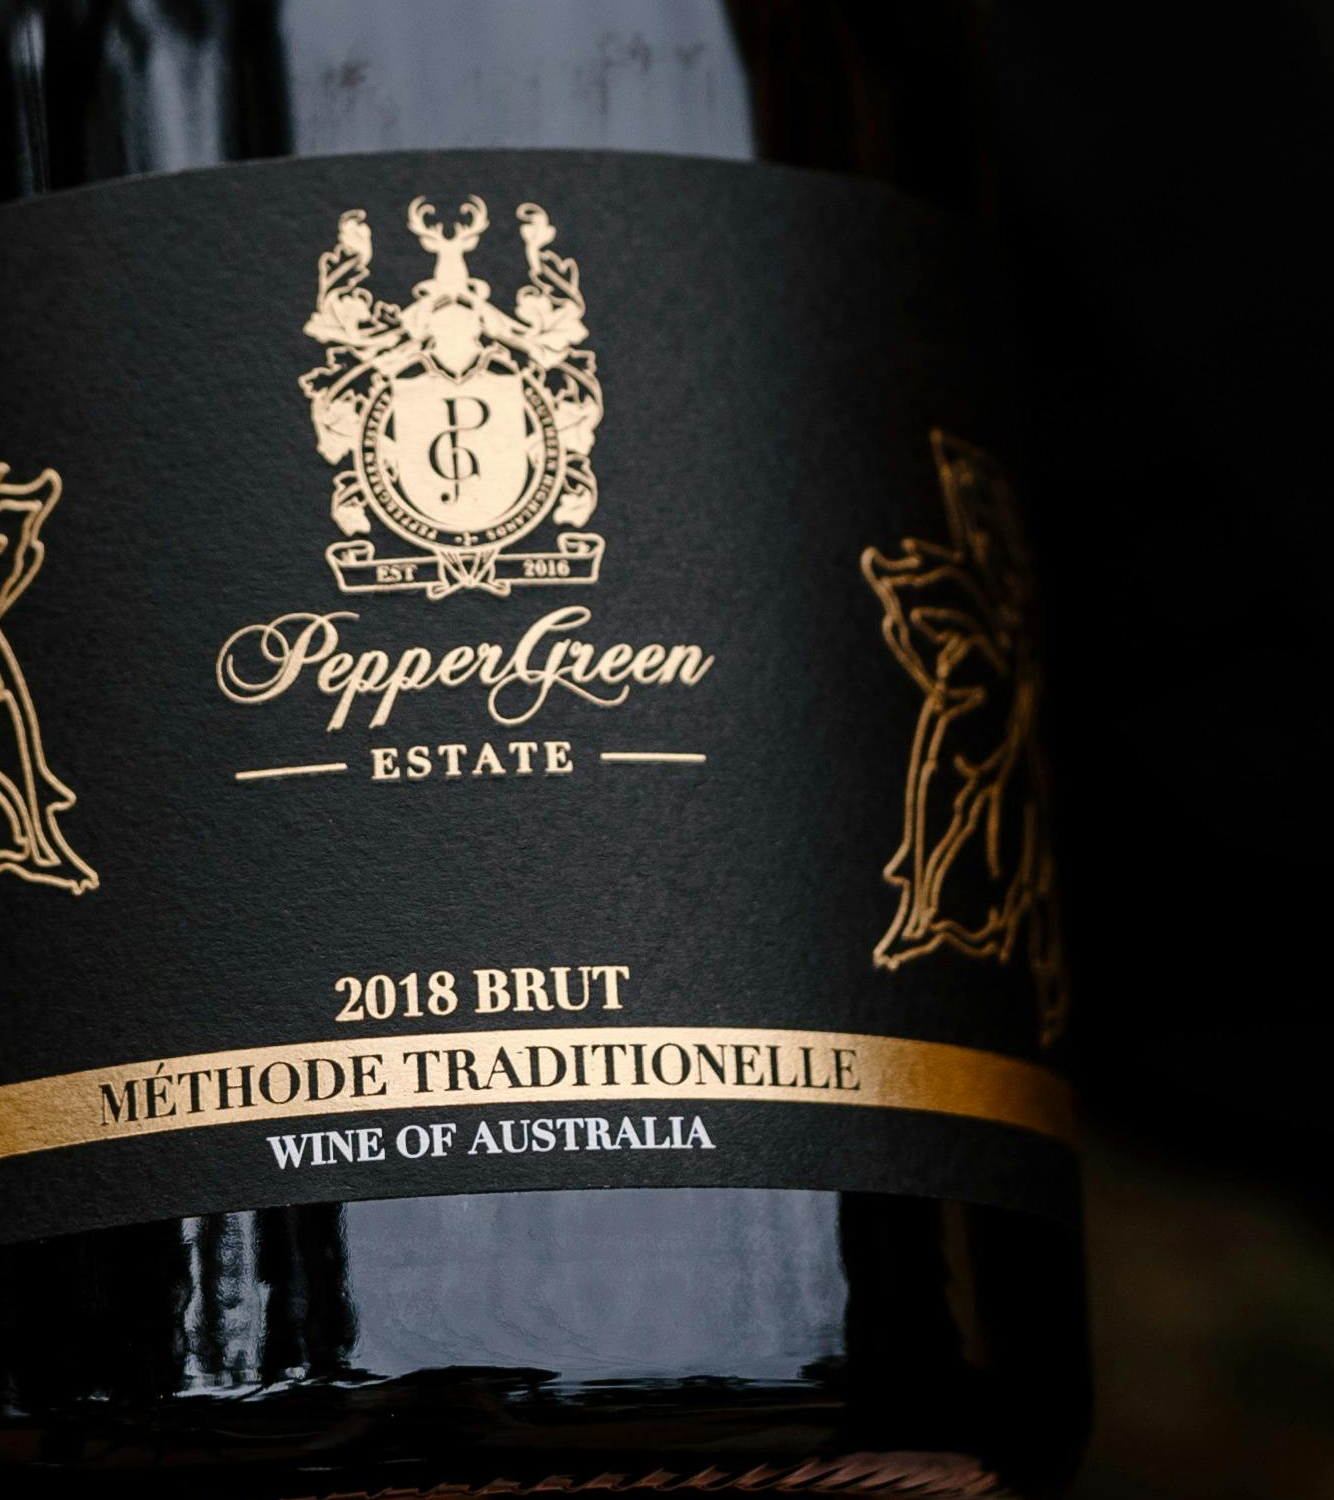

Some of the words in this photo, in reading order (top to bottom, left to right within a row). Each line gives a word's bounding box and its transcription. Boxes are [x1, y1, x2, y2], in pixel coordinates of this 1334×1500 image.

[375, 563, 418, 584] EST
[522, 558, 571, 578] 2016
[215, 605, 715, 732] PepperGreen
[370, 741, 575, 782] ESTATE
[334, 970, 459, 1023] 2018
[473, 965, 630, 1014] BRUT
[99, 1053, 388, 1127] MÉTHODE
[402, 1042, 863, 1096] TRADITIONELLE
[266, 1126, 386, 1170] WINE
[395, 1123, 458, 1159] OF
[468, 1115, 717, 1155] AUSTRALIA
